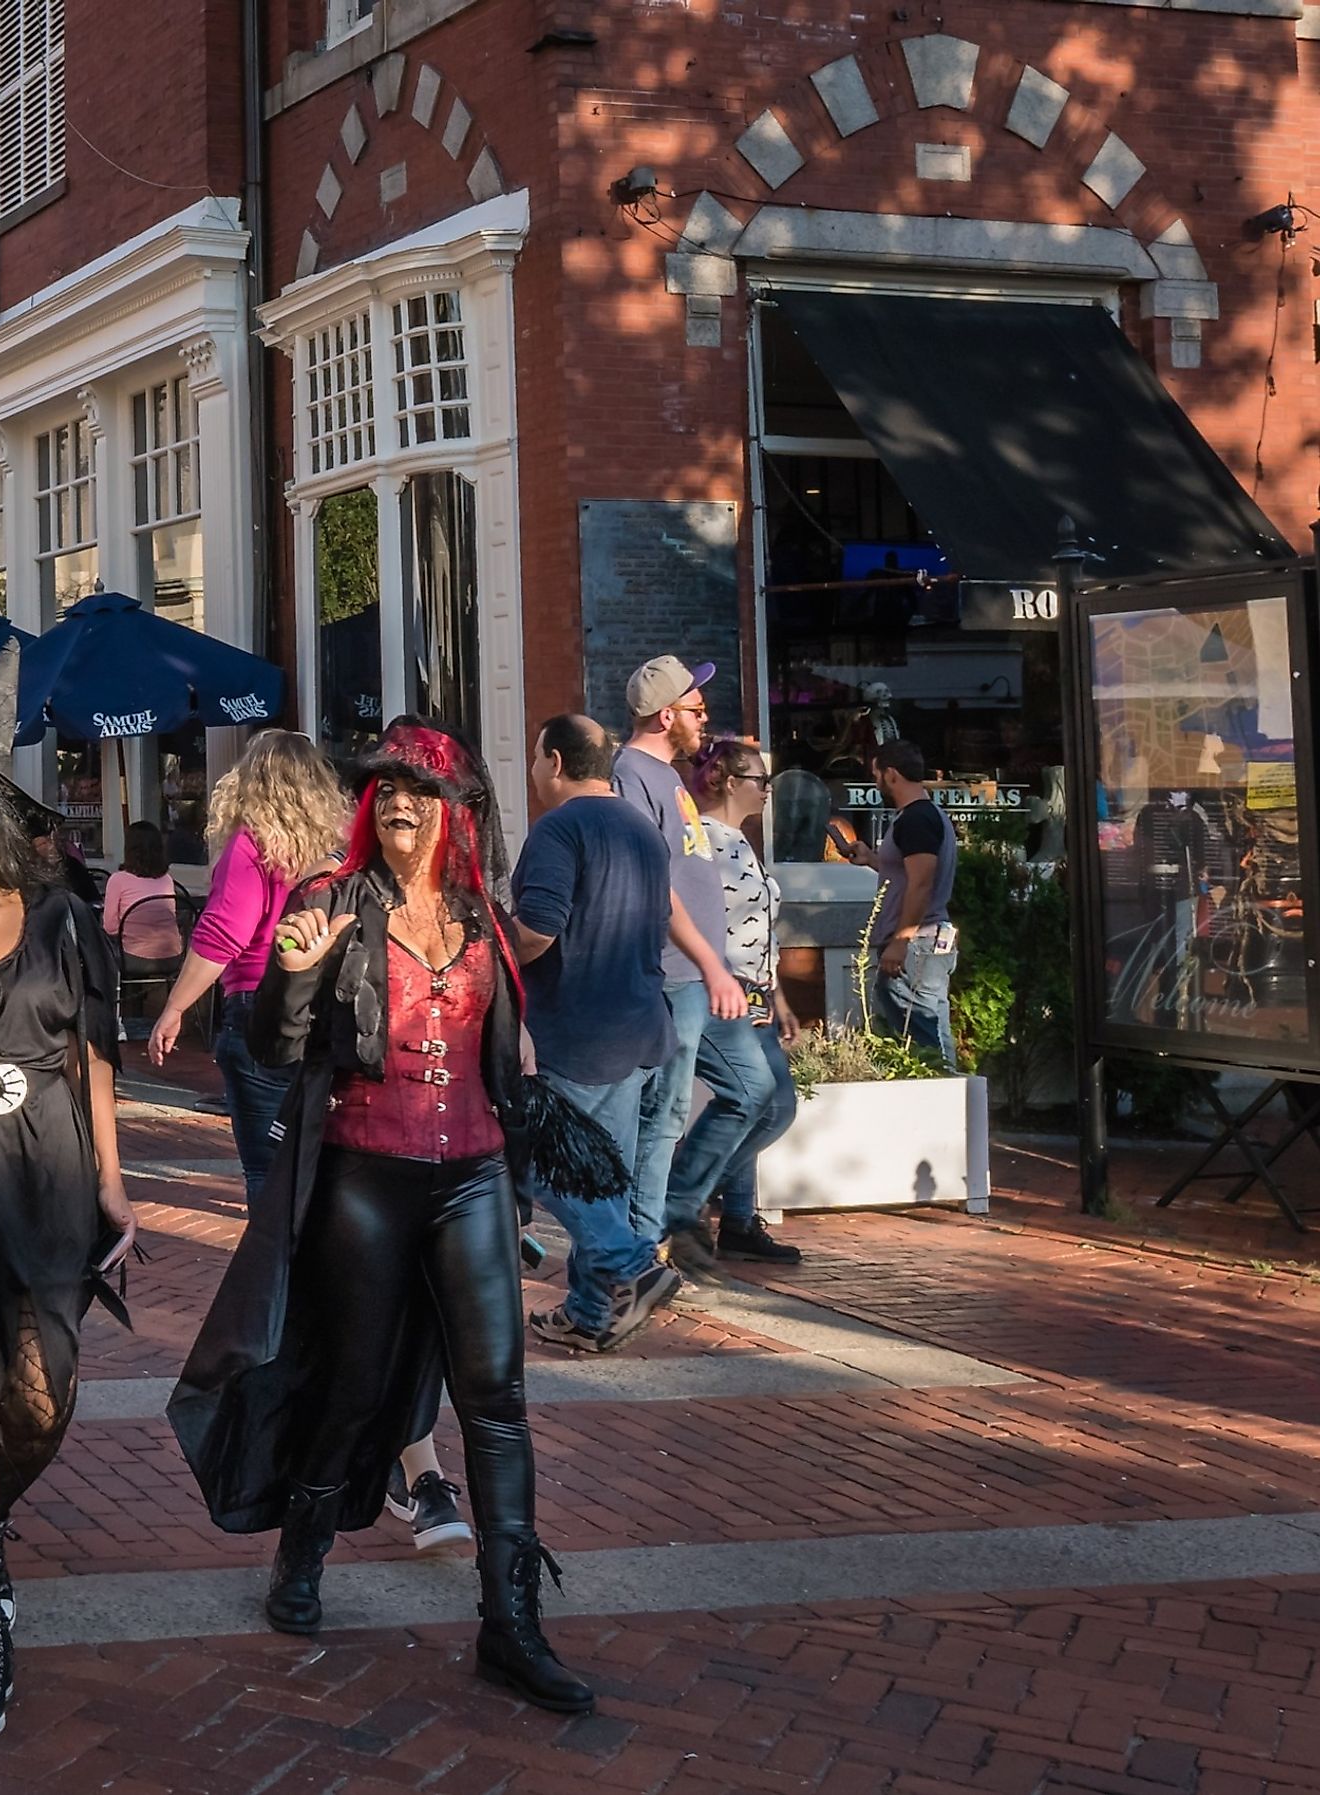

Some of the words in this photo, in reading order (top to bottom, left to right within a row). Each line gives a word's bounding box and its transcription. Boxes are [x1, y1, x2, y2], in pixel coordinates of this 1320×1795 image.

[220, 693, 266, 713] SAMUEL
[92, 709, 158, 726] SAMUEL
[100, 722, 153, 738] ADAMS
